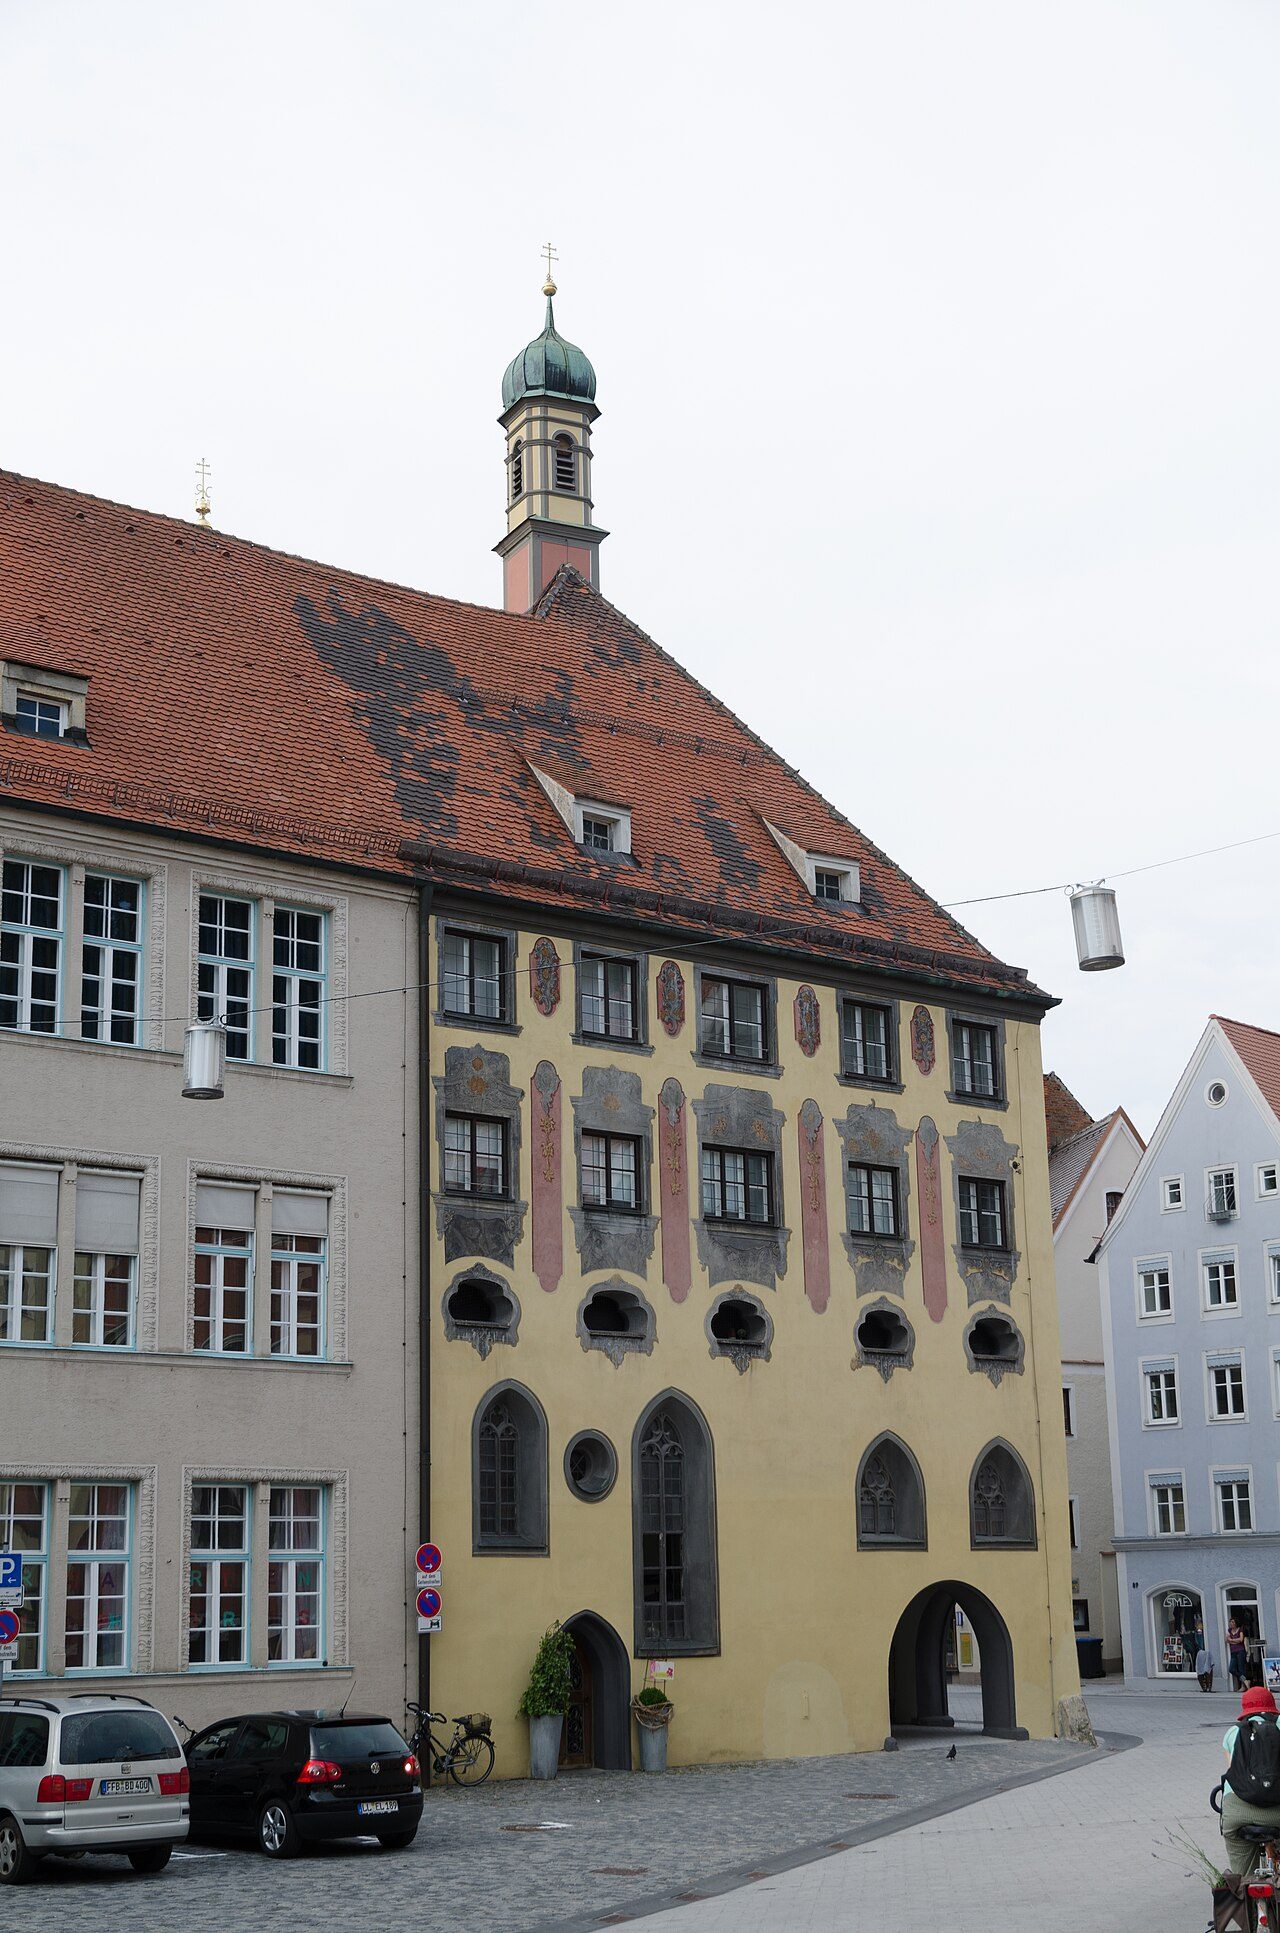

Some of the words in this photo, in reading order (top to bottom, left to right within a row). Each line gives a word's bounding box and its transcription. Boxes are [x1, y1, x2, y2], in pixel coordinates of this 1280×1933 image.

[1166, 1597, 1189, 1606] STYLE
[106, 1781, 120, 1791] FFB
[135, 1780, 148, 1790] 400
